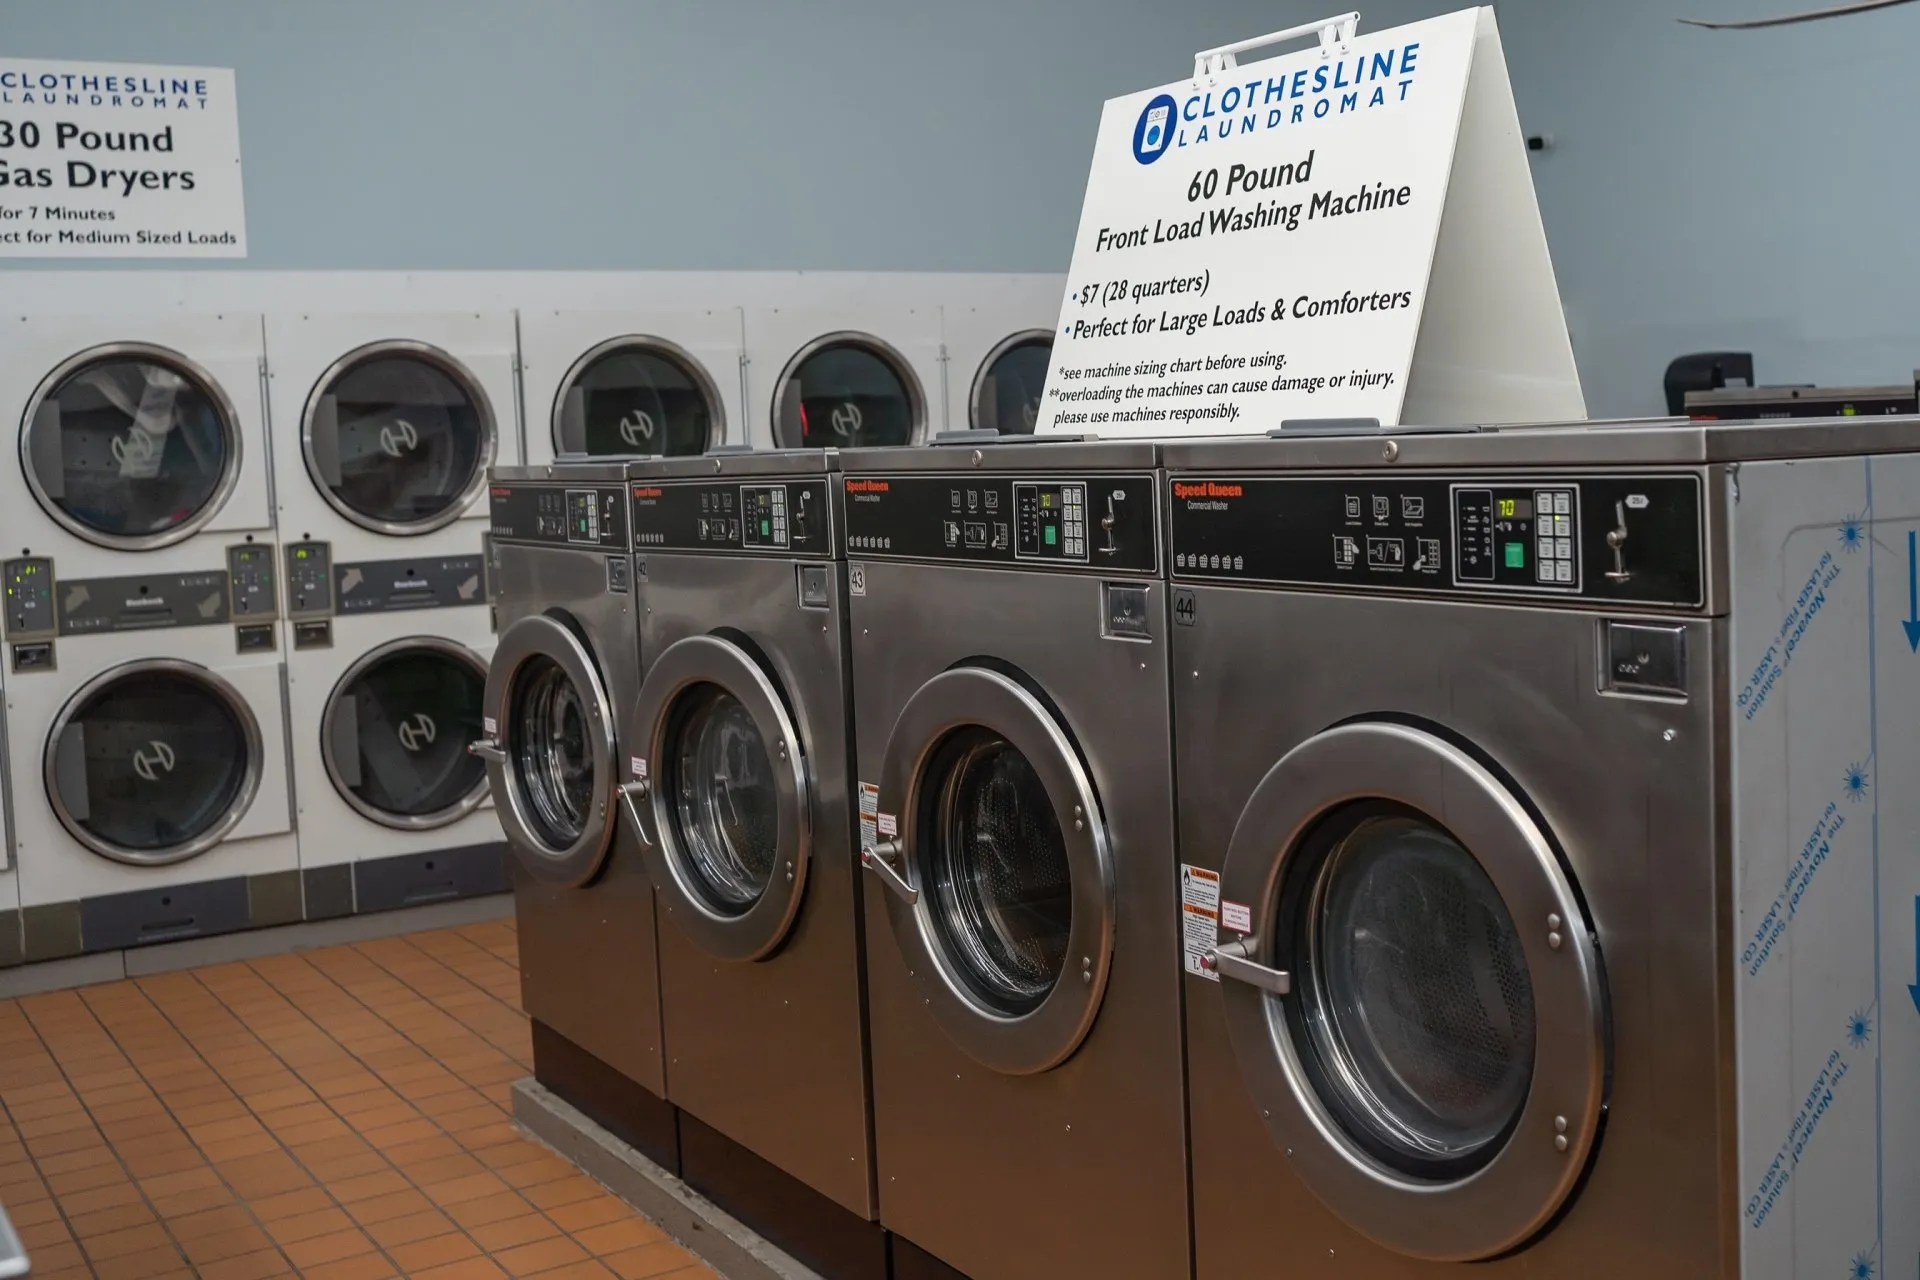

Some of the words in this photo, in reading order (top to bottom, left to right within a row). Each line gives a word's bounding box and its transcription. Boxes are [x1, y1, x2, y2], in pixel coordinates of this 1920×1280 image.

[0, 72, 208, 95] CLOTHESLINE
[1183, 43, 1420, 122] CLOTHESLINE
[3, 92, 208, 110] LAUNDROMAT
[1178, 80, 1413, 148] LAUNDROMAT
[0, 120, 40, 149] 30
[56, 121, 174, 152] Pound
[67, 160, 196, 198] Dryers
[1188, 168, 1219, 203] 60
[1226, 149, 1315, 196] Pound
[29, 206, 38, 220] 7
[46, 206, 115, 221] Minutes
[1096, 225, 1149, 253] Front
[1153, 212, 1205, 244] Load
[1209, 199, 1302, 235] Washing
[1308, 181, 1411, 220] Machine
[27, 229, 52, 244] for
[59, 230, 130, 244] Medium
[137, 230, 182, 244] Sized
[188, 231, 237, 245] Loads
[1080, 283, 1100, 307] $7
[1102, 279, 1128, 308] (28
[1132, 269, 1210, 304] quarters)
[1073, 317, 1128, 340] Perfect
[1132, 313, 1156, 335] for
[1159, 311, 1207, 336] Large
[1213, 300, 1266, 326] Loads
[1270, 298, 1286, 321] &
[1292, 290, 1412, 319] Comforters
[1084, 362, 1131, 380] machine
[1134, 360, 1167, 378] sizing
[1170, 358, 1203, 373] chart
[1205, 354, 1246, 371] before
[1250, 351, 1287, 371] using.
[1125, 384, 1144, 399] the
[1147, 381, 1204, 398] machines
[1206, 383, 1228, 395] can
[1231, 380, 1268, 393] cause
[1271, 375, 1325, 394] damage
[1329, 374, 1346, 388] or
[1349, 369, 1395, 390] injury.
[1053, 409, 1088, 428] please
[1090, 410, 1110, 423] use
[1112, 406, 1167, 422] machines
[1170, 402, 1240, 424] responsibly.
[846, 480, 867, 493] Speed
[868, 480, 888, 491] Queen
[1041, 494, 1051, 507] 70
[1174, 482, 1206, 499] Speed
[1208, 482, 1242, 497] Queen
[1187, 500, 1211, 511] Commercial
[1212, 500, 1228, 511] Washer
[1499, 499, 1515, 517] 70
[1820, 551, 1833, 569] for
[851, 571, 863, 588] 43
[1797, 568, 1823, 608] LASER
[1823, 564, 1841, 588] The
[1176, 597, 1194, 620] 44
[1751, 646, 1778, 686] LASER
[1745, 664, 1782, 720] Solution
[1823, 801, 1836, 820] for
[1801, 819, 1826, 860] LASER
[1828, 814, 1846, 839] The
[1755, 900, 1782, 941] LASER
[1749, 919, 1786, 976] Solution
[1826, 1050, 1840, 1068] for
[1831, 1062, 1848, 1087] The
[1805, 1069, 1830, 1110] LASER
[1758, 1152, 1785, 1194] LASER
[1753, 1170, 1790, 1229] Solution
